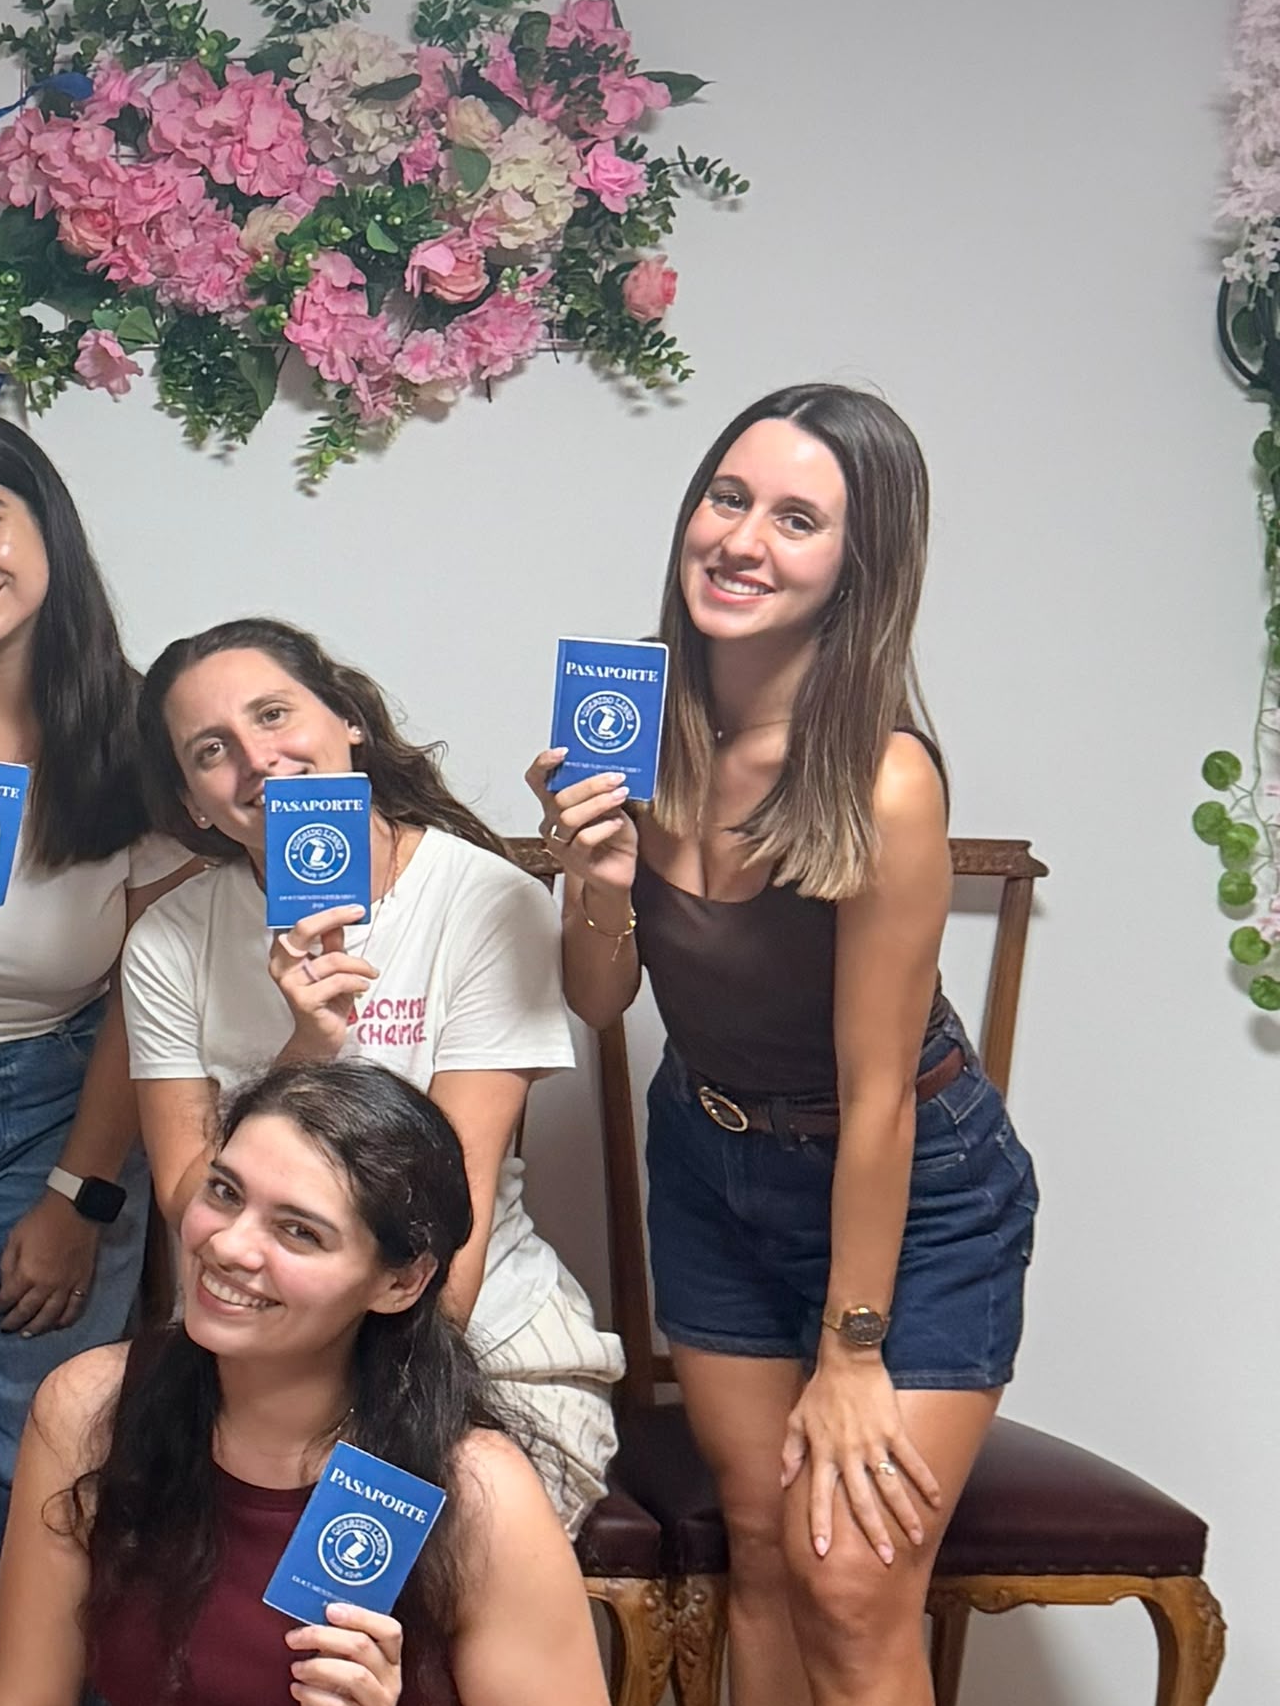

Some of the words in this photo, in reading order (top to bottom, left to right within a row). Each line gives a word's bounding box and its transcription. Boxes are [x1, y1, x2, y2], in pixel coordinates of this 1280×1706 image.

[566, 661, 658, 682] PASAPORTE
[270, 799, 363, 813] PASAPORTE
[329, 1467, 428, 1524] PASAPORTE
